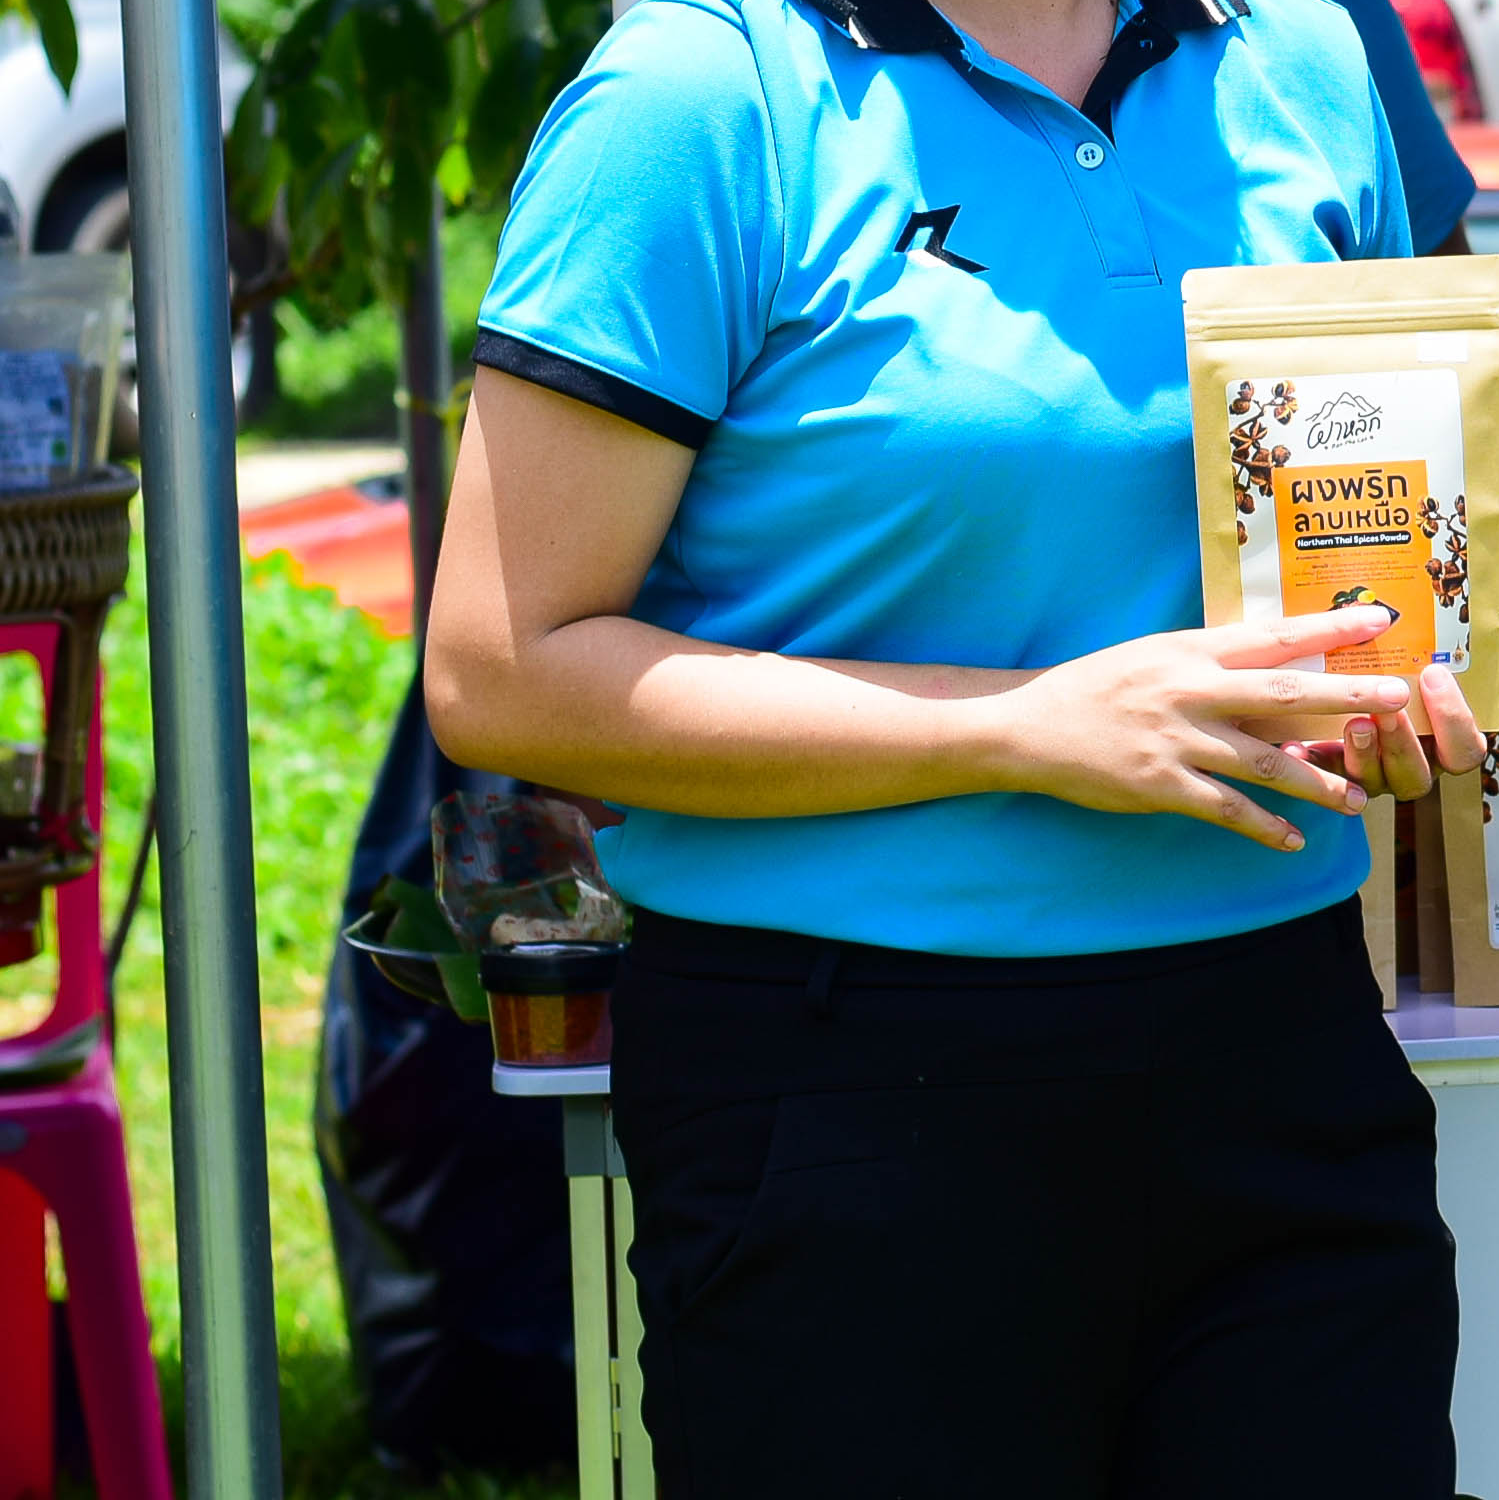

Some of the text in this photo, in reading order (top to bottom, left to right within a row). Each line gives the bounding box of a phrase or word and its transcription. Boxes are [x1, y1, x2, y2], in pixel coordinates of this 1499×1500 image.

[1306, 406, 1382, 450] ผาหลัก
[1291, 469, 1408, 505] ผงพริก
[1294, 500, 1410, 533] ลาบเหนือ
[1297, 532, 1410, 548] Northern Thai Spices Powder
